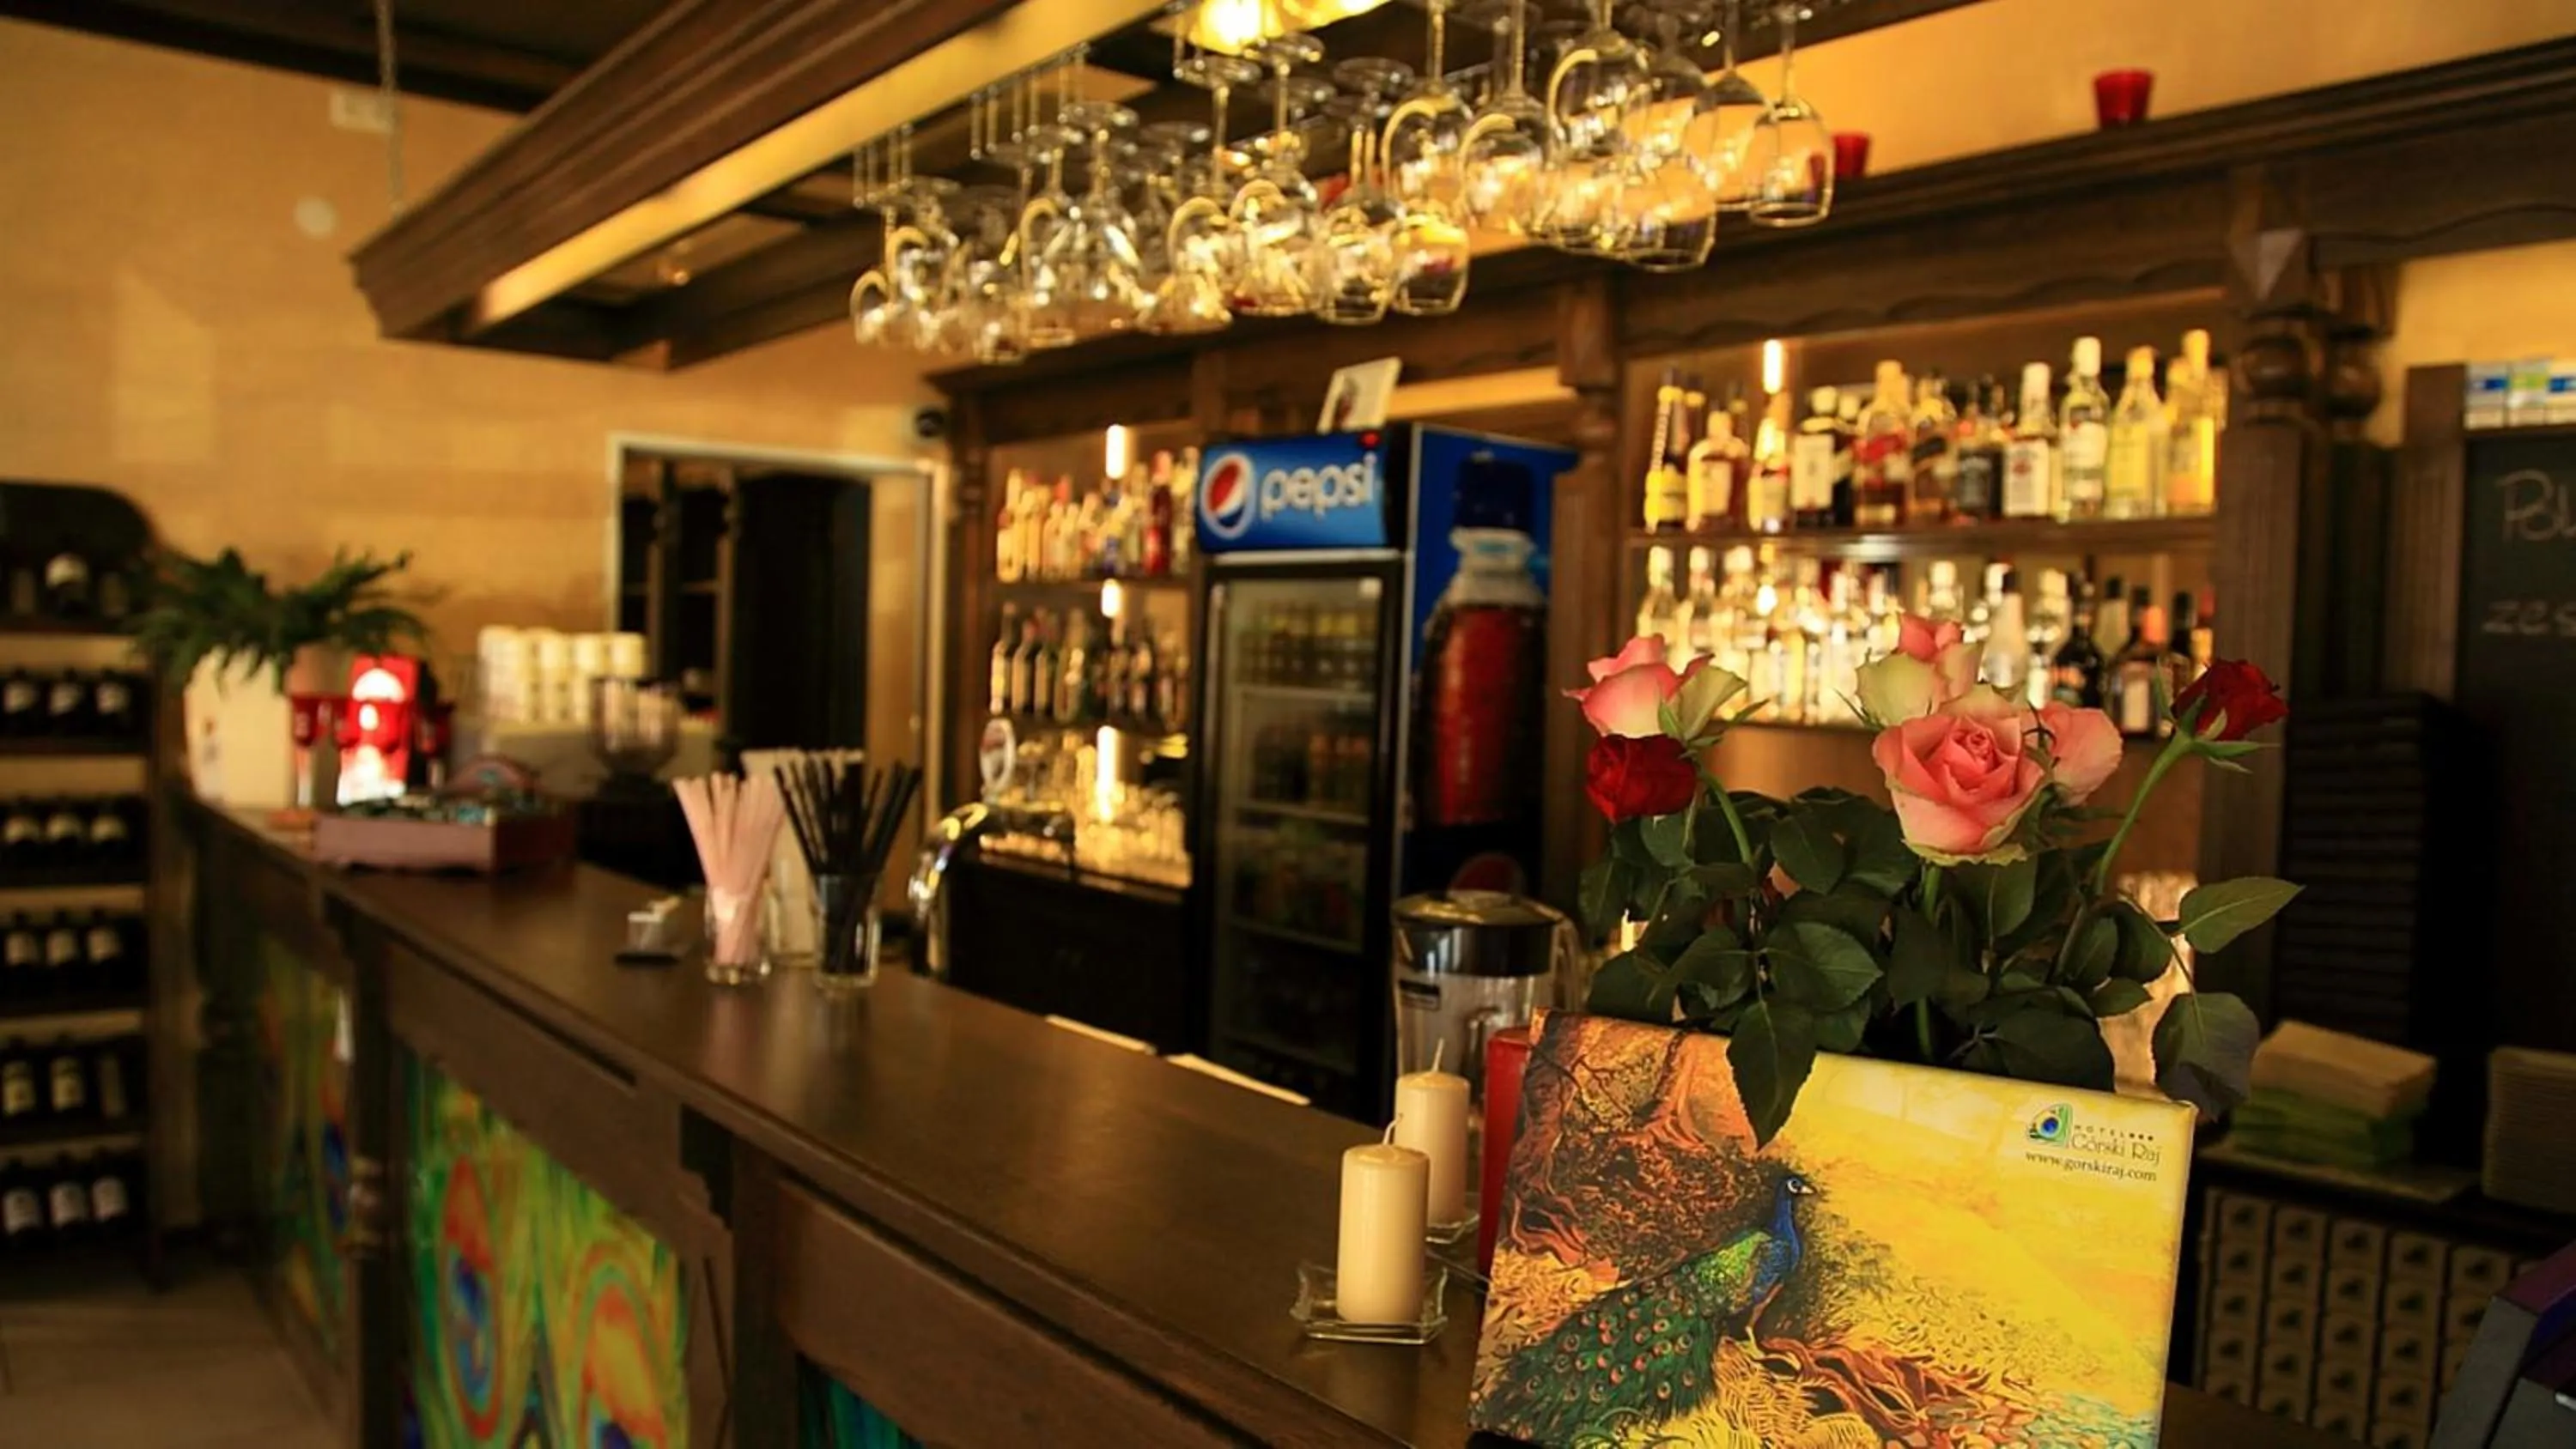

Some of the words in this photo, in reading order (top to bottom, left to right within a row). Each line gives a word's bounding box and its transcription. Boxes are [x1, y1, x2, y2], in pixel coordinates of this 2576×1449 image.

[1261, 452, 1376, 522] pepsi
[2025, 1150, 2157, 1182] www.gorskiraj.com
[2131, 1142, 2160, 1164] Raj
